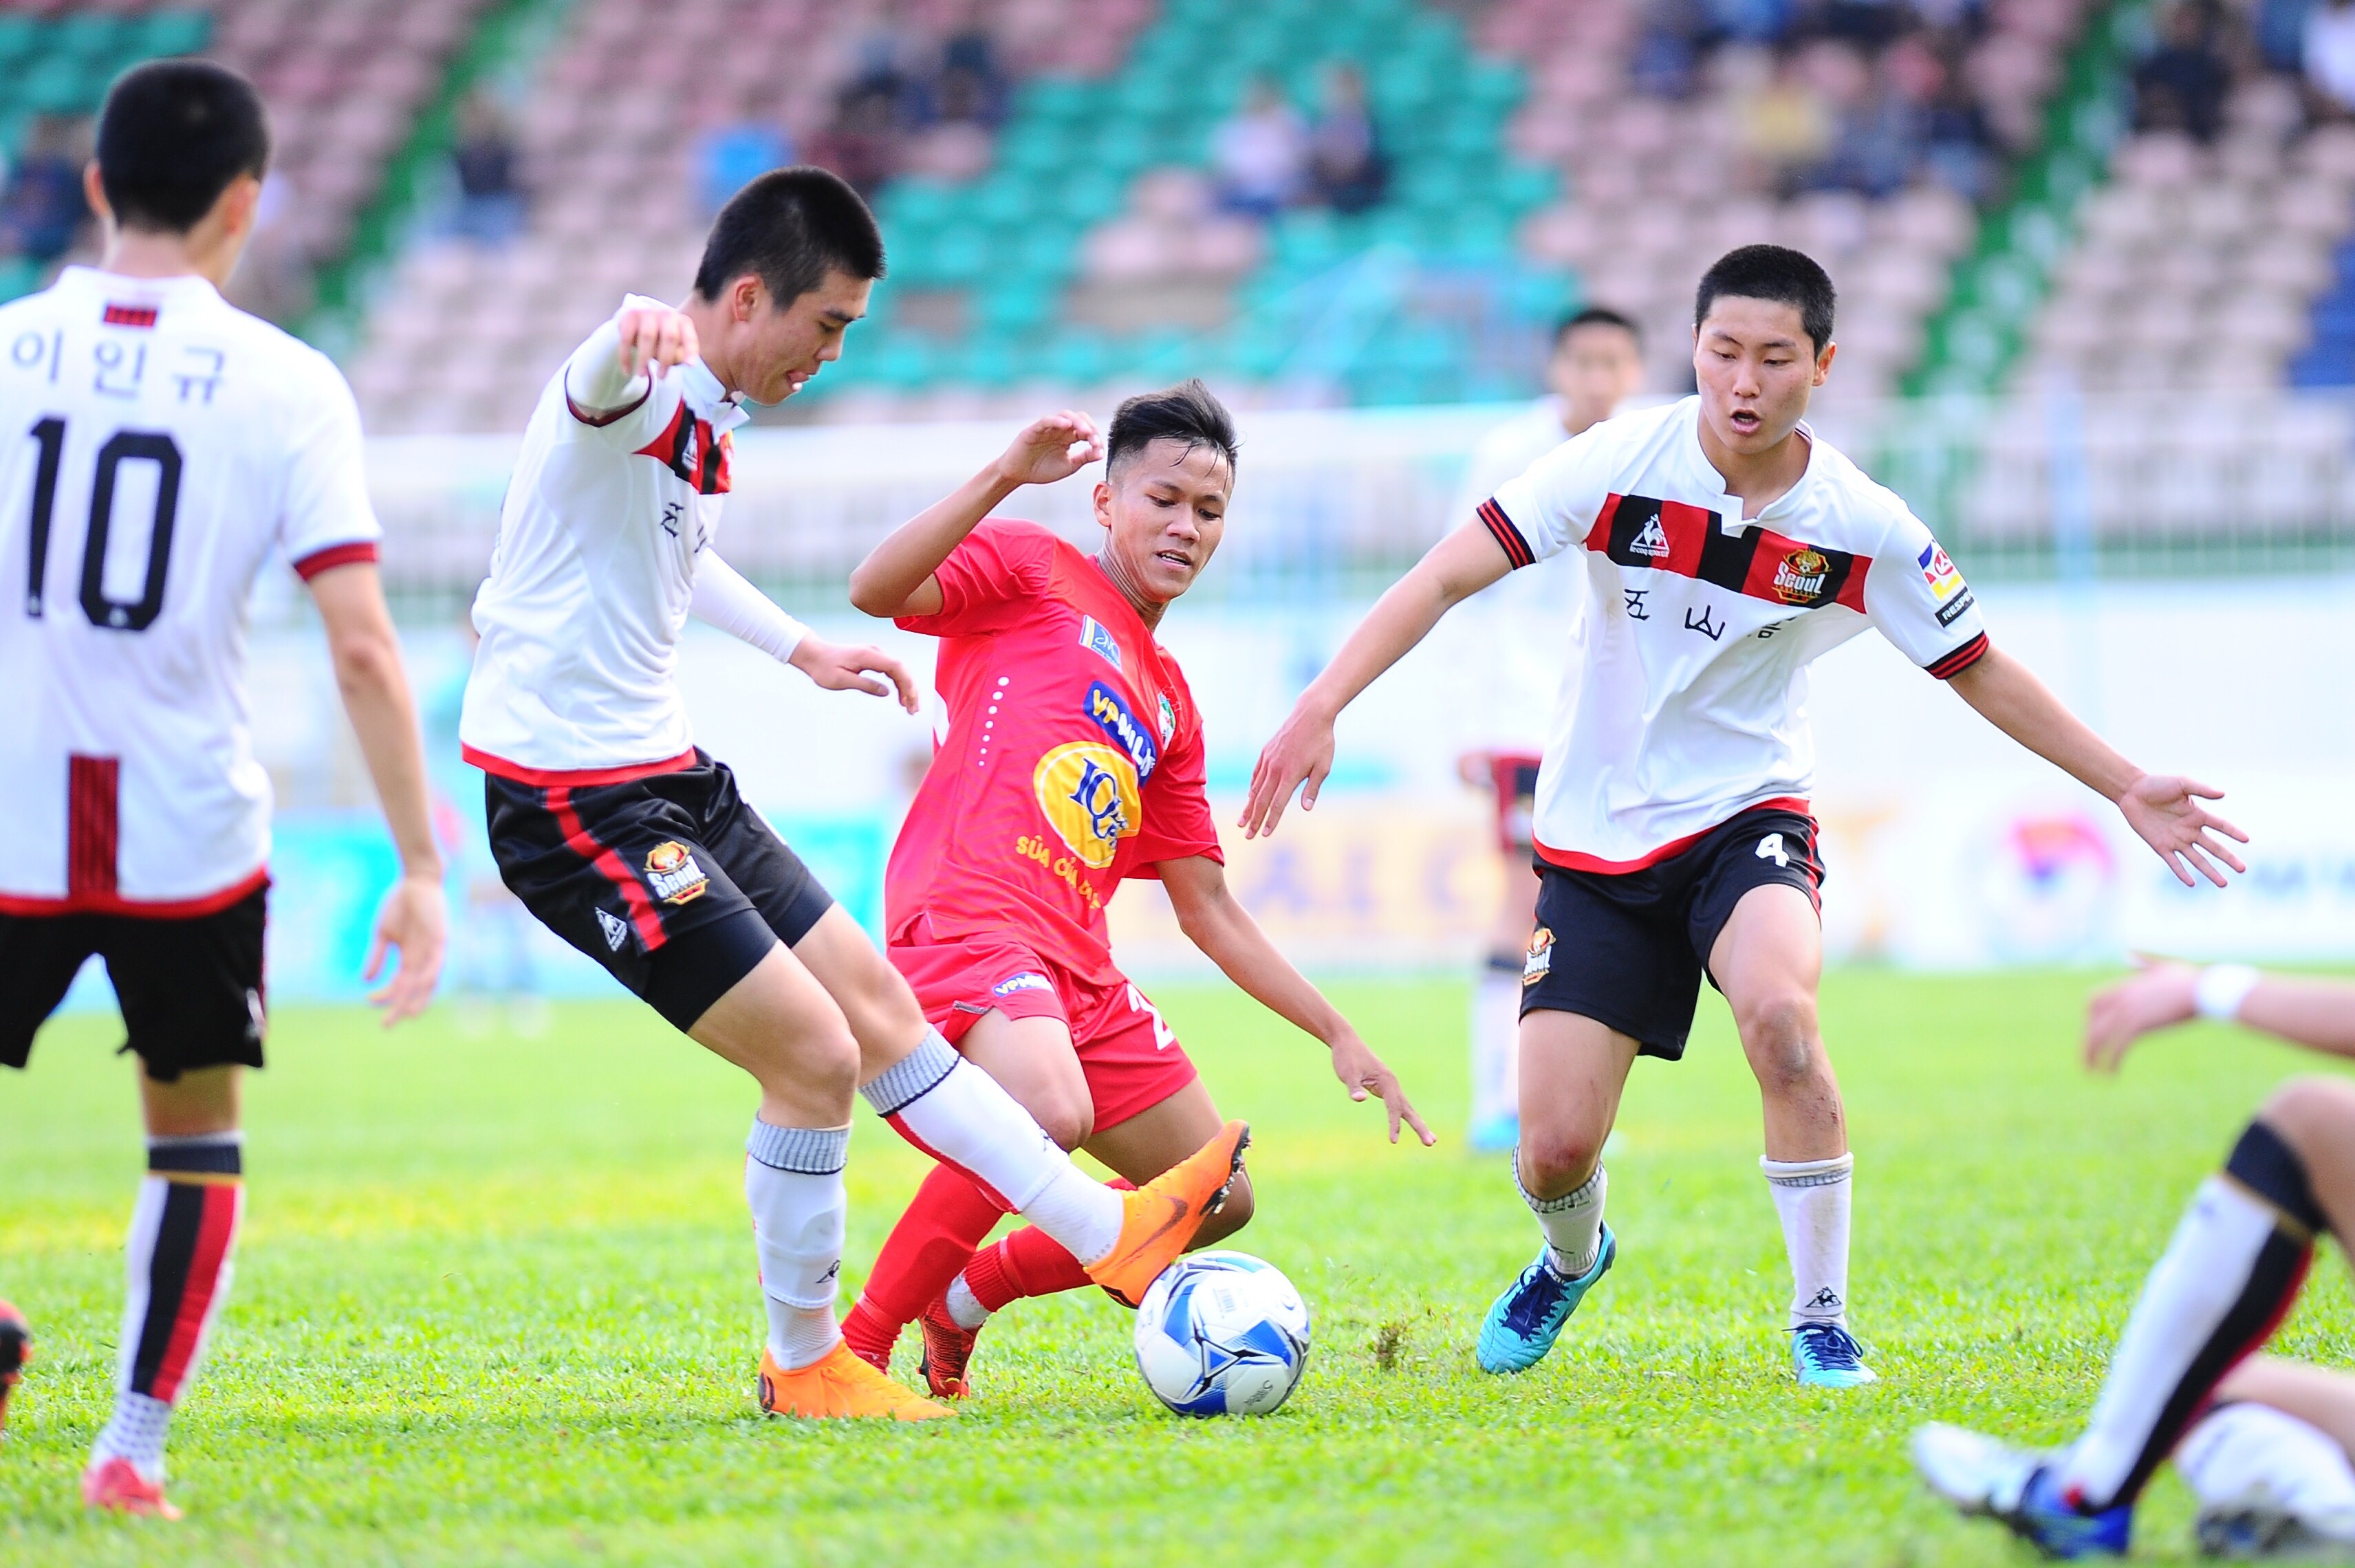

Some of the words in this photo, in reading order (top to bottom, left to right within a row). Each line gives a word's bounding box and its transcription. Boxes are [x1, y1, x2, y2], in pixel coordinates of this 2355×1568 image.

[12, 329, 226, 403] 이인규
[25, 415, 183, 631] 10
[1773, 560, 1826, 594] Seoul
[1942, 591, 1973, 620] RESPE
[1755, 834, 1789, 867] 4
[647, 855, 706, 899] Seoul
[1127, 983, 1175, 1051] 2
